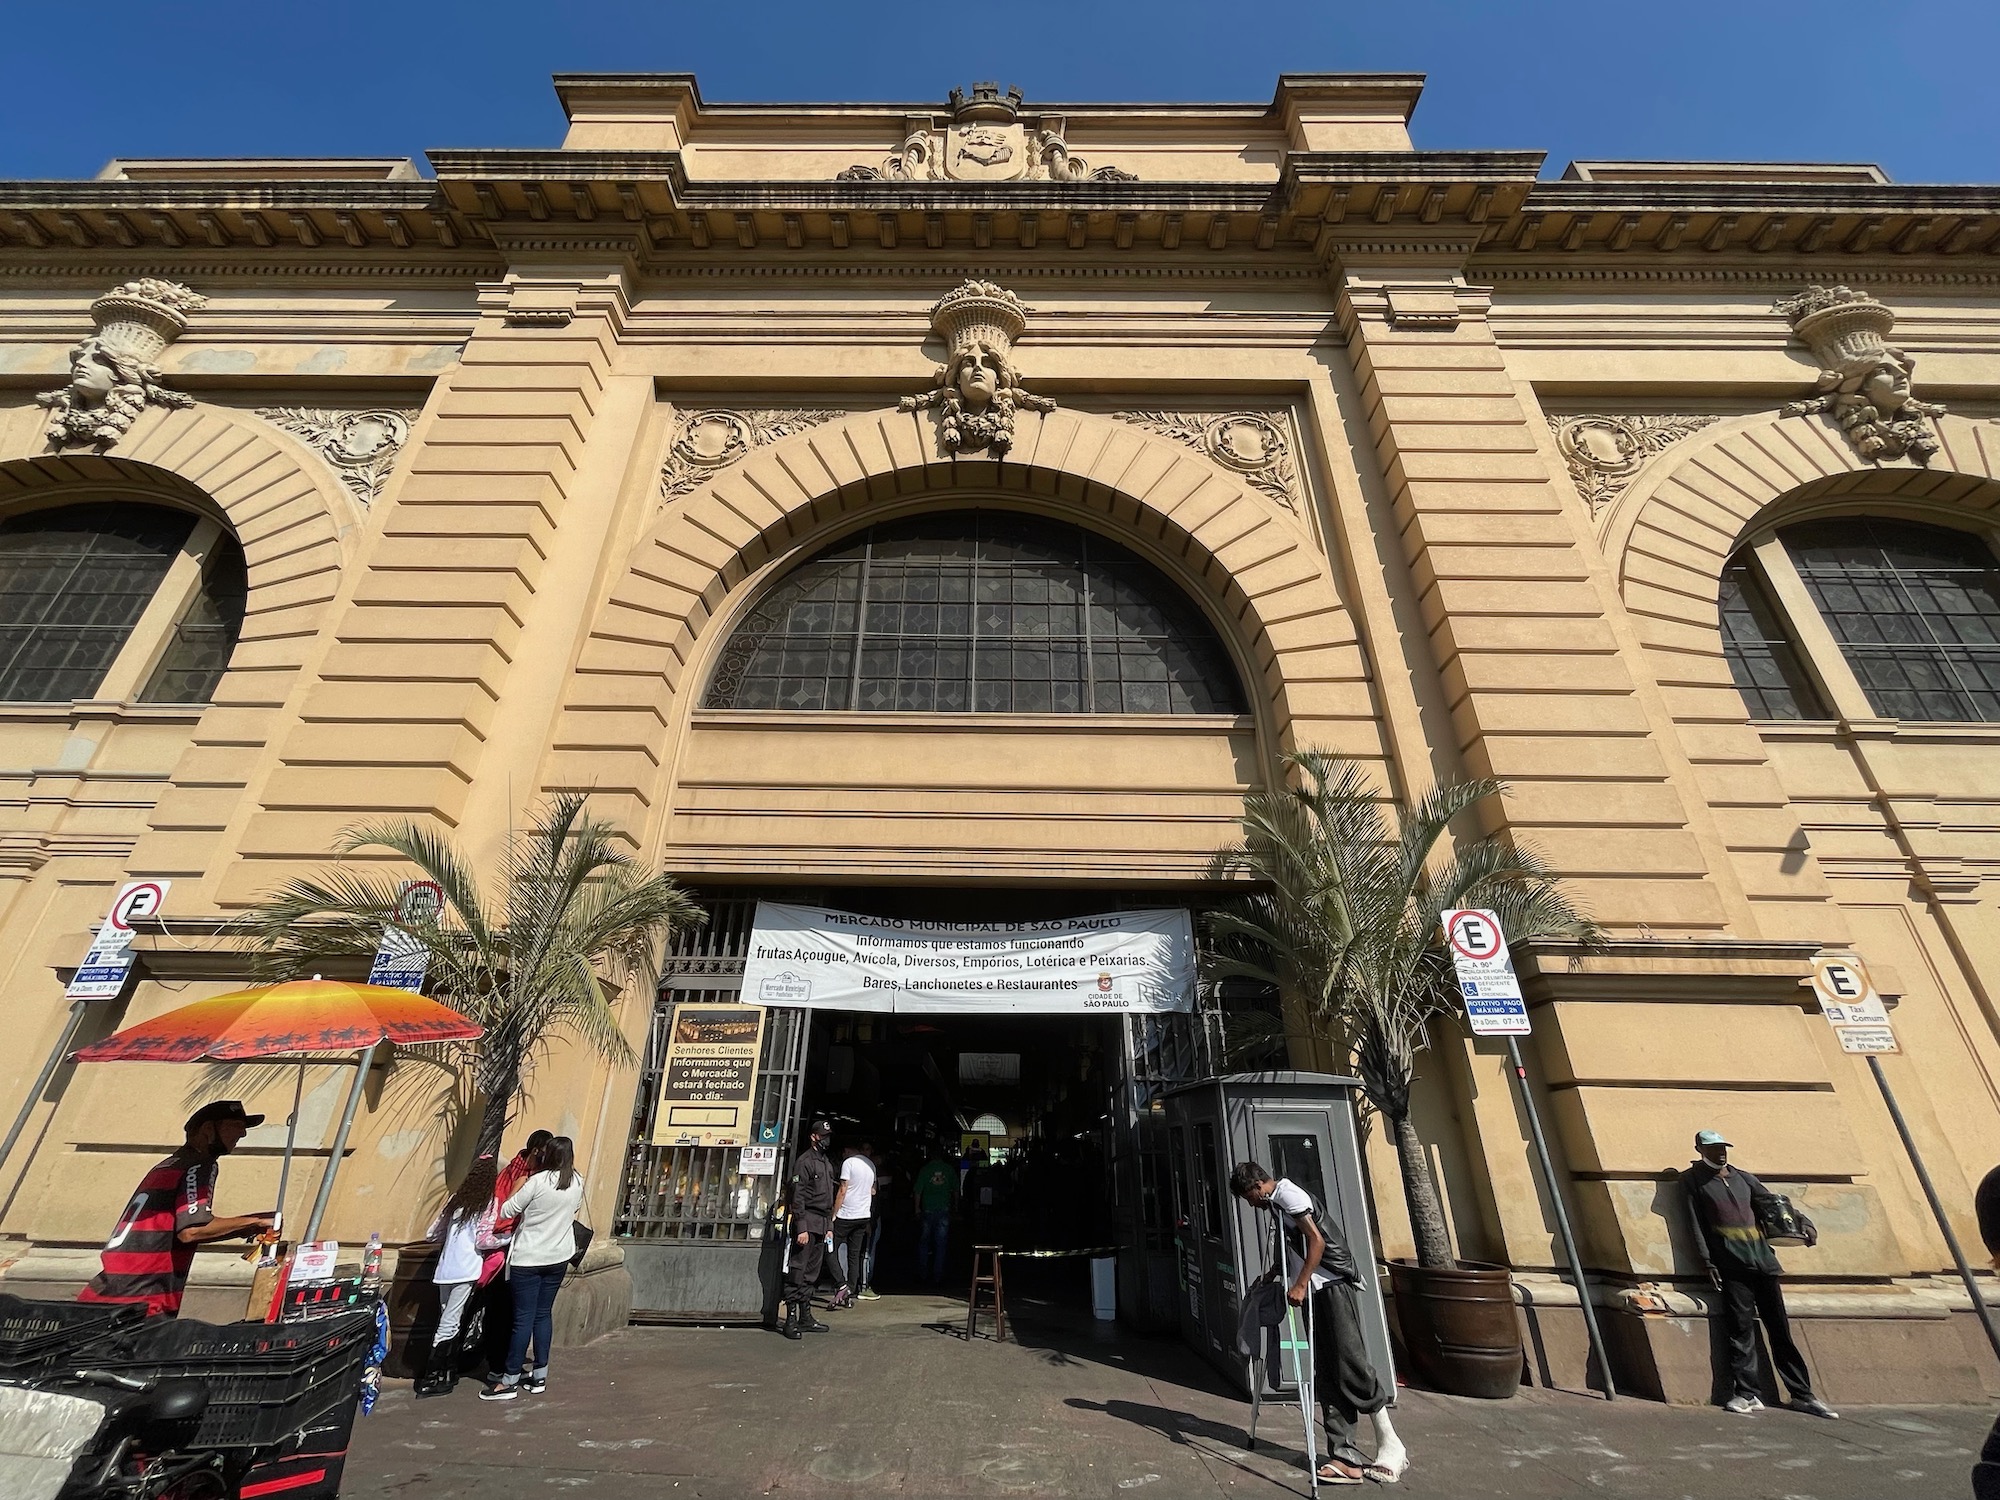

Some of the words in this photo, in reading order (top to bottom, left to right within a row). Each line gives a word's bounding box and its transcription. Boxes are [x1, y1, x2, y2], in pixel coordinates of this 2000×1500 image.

[825, 914, 905, 929] MERCADO
[909, 920, 1000, 932] MUNICIPAL
[1005, 922, 1025, 932] DE
[1068, 917, 1121, 930] PAULO
[1463, 921, 1487, 949] E
[856, 934, 928, 949] Informamos
[931, 940, 953, 952] que
[956, 940, 1007, 950] estamos
[1010, 937, 1084, 950] funcionando
[853, 952, 900, 968] Avícola,
[904, 955, 959, 969] Diversos,
[963, 956, 1023, 970] Empórios,
[1026, 955, 1076, 967] Lotérica
[1079, 958, 1086, 966] e
[1090, 954, 1150, 967] Peixarias.
[863, 976, 901, 991] Bares,
[905, 978, 983, 990] Lanchonetes
[986, 981, 993, 990] e
[997, 979, 1078, 990] Restaurantes
[1826, 966, 1857, 995] E
[1083, 999, 1101, 1008] SÃO
[1102, 1000, 1130, 1008] PAULO
[675, 1045, 715, 1055] Senhores
[718, 1046, 754, 1055] Clientes
[672, 1058, 730, 1067] Informamos
[732, 1060, 751, 1068] que
[682, 1070, 689, 1078] o
[690, 1069, 739, 1078] Mercadão
[672, 1080, 703, 1089] estará
[705, 1080, 745, 1089] fechado
[690, 1092, 703, 1100] no
[705, 1091, 724, 1100] dia:
[186, 1164, 201, 1215] bozzano
